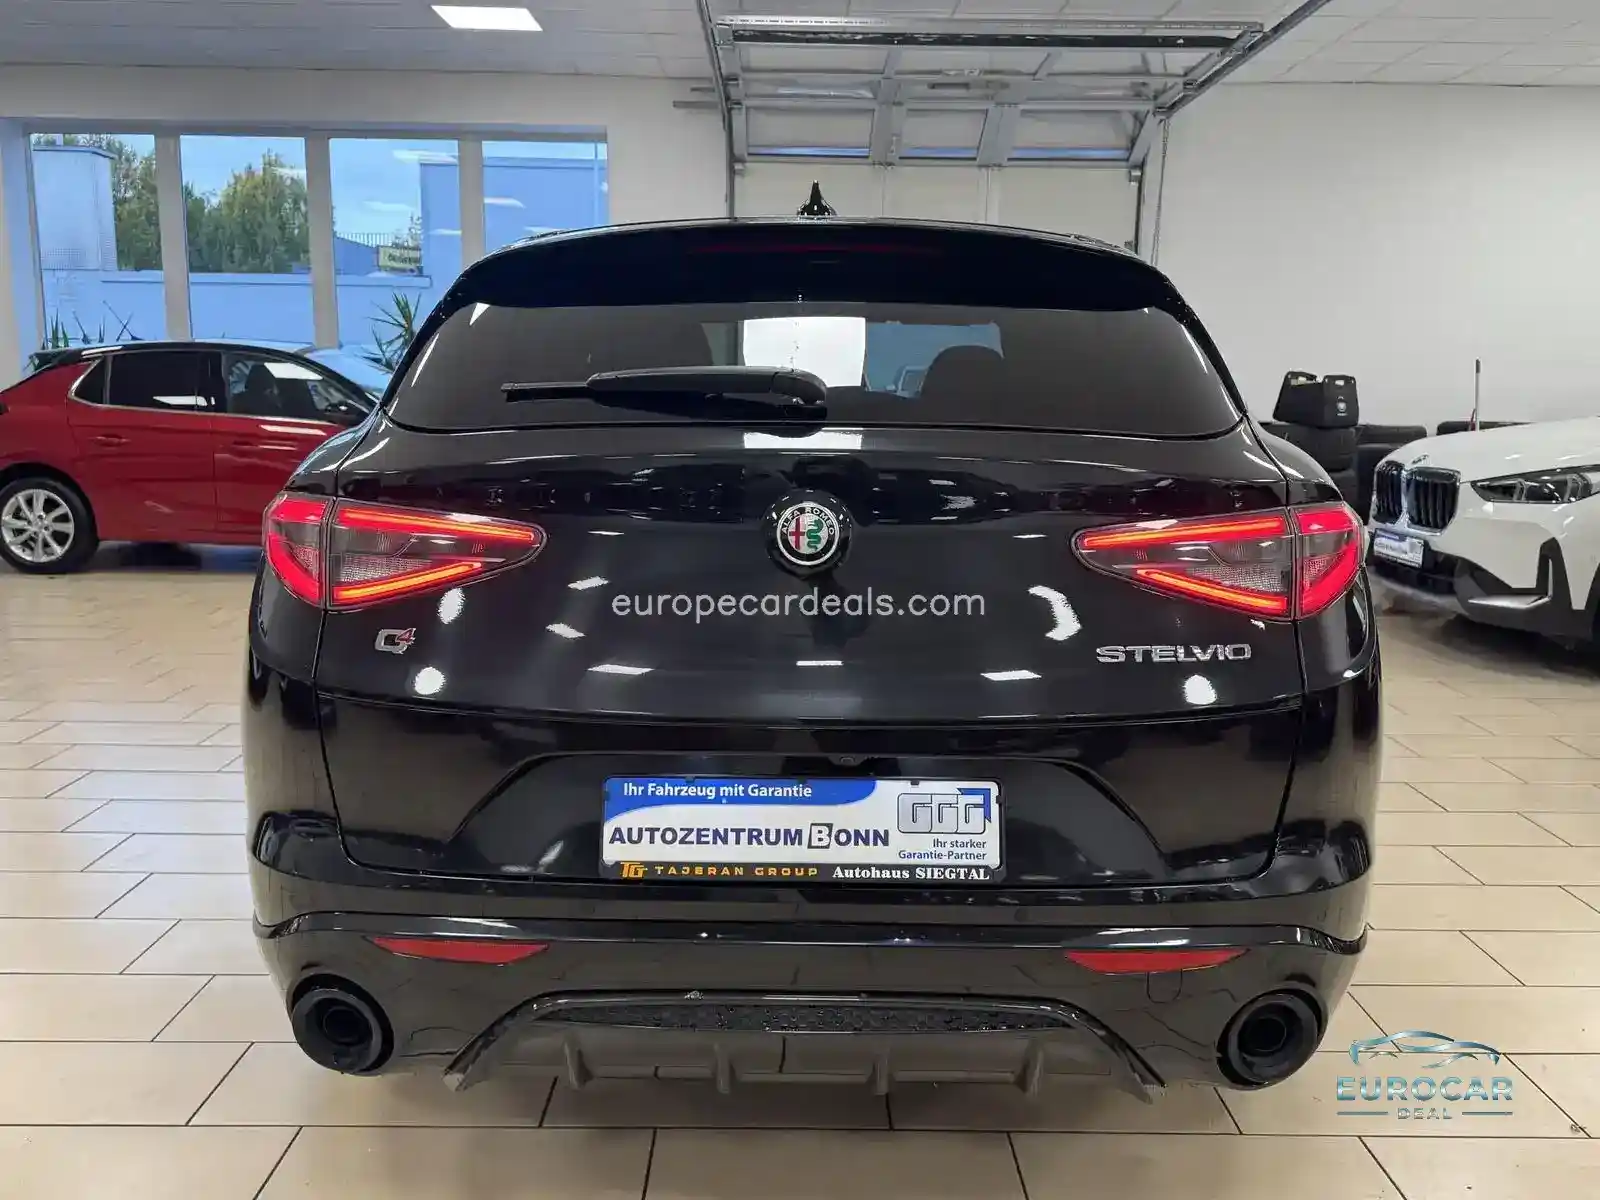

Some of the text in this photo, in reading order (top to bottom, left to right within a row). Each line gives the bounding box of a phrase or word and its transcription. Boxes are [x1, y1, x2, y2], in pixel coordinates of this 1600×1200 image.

[781, 506, 835, 536] ALFA ROMEO
[1096, 643, 1252, 663] STELVIO
[623, 782, 813, 800] Ihr Fahrzeug mit Garantie
[609, 823, 890, 849] AUTOZENTRUM BONN
[933, 838, 987, 849] Ihr starker
[898, 849, 987, 861] Garantie-Partner
[654, 865, 744, 877] TAJERAN
[754, 866, 819, 877] GROUP
[832, 866, 990, 881] Autohaus SIEGTAL
